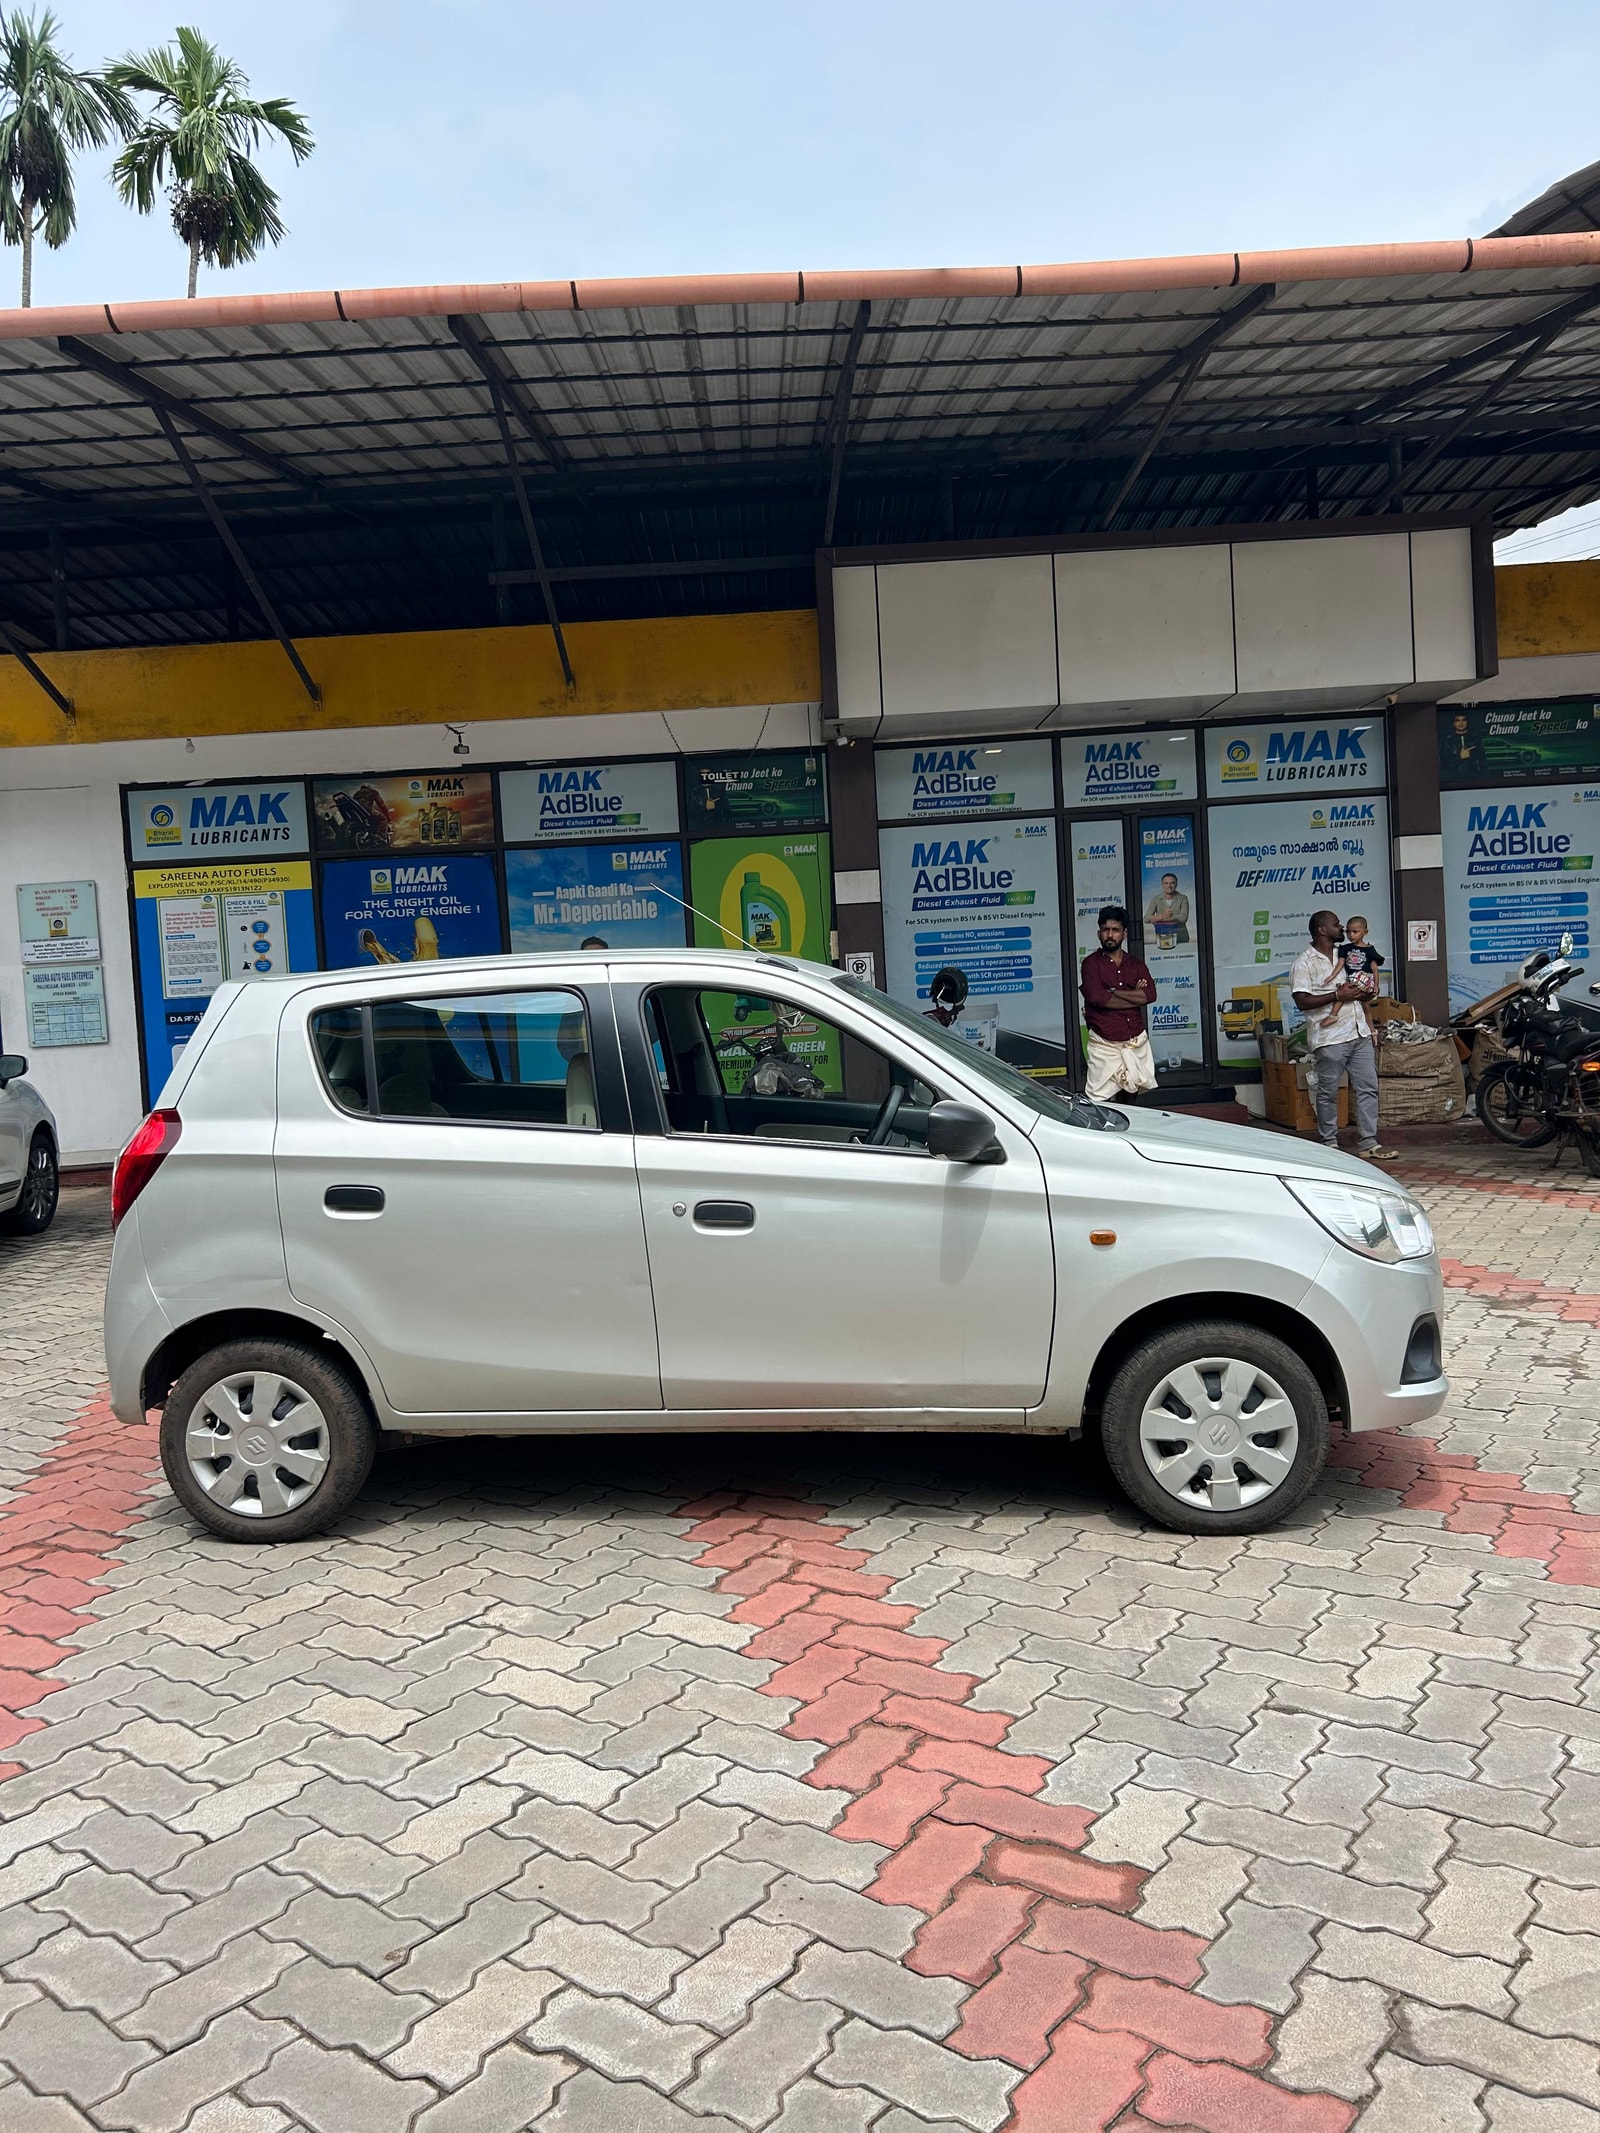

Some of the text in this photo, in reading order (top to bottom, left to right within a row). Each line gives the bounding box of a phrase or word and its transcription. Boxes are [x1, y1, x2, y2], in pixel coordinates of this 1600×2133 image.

[1485, 709, 1552, 724] Chuno Jeet ko
[1489, 719, 1588, 736] Chuno Speed ko
[1084, 740, 1144, 763] MAK
[1266, 728, 1369, 764] MAK
[912, 750, 978, 774] MAK
[701, 772, 739, 781] TOILET
[751, 767, 782, 779] Jeet ko
[1086, 762, 1160, 782] AdBlue
[1266, 762, 1368, 781] LUBRICANTS
[427, 778, 464, 792] MAK
[538, 770, 603, 794] MAK
[726, 782, 754, 791] Chuno
[806, 777, 816, 787] ko
[913, 774, 996, 795] AdBlue
[427, 790, 465, 798] LUBRICANTS
[540, 794, 623, 816] AdBlue
[917, 800, 938, 808] Diesel
[940, 798, 967, 806] Exhaust
[970, 797, 986, 805] Fluid
[190, 792, 290, 828] MAK
[1330, 804, 1376, 820] MAK
[1467, 802, 1549, 832] MAK
[544, 820, 564, 828] Diesel
[1024, 826, 1047, 834] MAK
[1330, 820, 1375, 828] LUBRICANTS
[191, 827, 290, 846] LUBRICANTS
[1157, 828, 1186, 840] MAK
[794, 844, 816, 853] MAK
[1089, 844, 1116, 854] MAK
[1232, 844, 1277, 862] നമ്മുടെ
[1280, 837, 1339, 855] സാക്ഷാൽ
[1468, 831, 1571, 858] AdBlue
[630, 850, 667, 864] MAK
[912, 838, 991, 868] MAK
[1472, 860, 1558, 872] Diesel Exhaust Fluid
[160, 868, 276, 882] SAREENA AUTO FUELS
[395, 866, 448, 884] MAK
[912, 866, 1013, 894] AdBlue
[1236, 864, 1358, 888] DEFINITELY MAK
[396, 884, 448, 894] LUBRICANTS
[556, 883, 634, 900] Aapki Gaadi Ka
[1312, 880, 1371, 894] AdBlue
[362, 896, 462, 909] THE RIGHT OIL
[917, 896, 1000, 908] Diesel Exhaust Fluid
[345, 910, 374, 920] FOR
[378, 908, 416, 918] YOUR
[420, 906, 472, 916] ENGINE
[534, 899, 658, 925] Mr. Dependable
[750, 912, 770, 920] MAK
[1020, 912, 1046, 920] Engines
[1498, 909, 1560, 918] Environment friendly
[941, 932, 964, 940] Reduces
[977, 930, 1005, 938] emissions
[1498, 926, 1535, 934] maintenance
[1541, 924, 1570, 932] operating
[944, 944, 1003, 954] Environment friendly
[1488, 940, 1521, 948] Compatible
[1522, 938, 1535, 946] with
[943, 960, 980, 968] maintenance
[986, 958, 1014, 966] operating
[1480, 954, 1496, 962] Meets
[992, 970, 1015, 978] systems
[1152, 1004, 1180, 1015] MAK
[1152, 1014, 1188, 1024] AdBlue
[790, 1041, 826, 1053] GREEN
[814, 1054, 828, 1065] FOR
